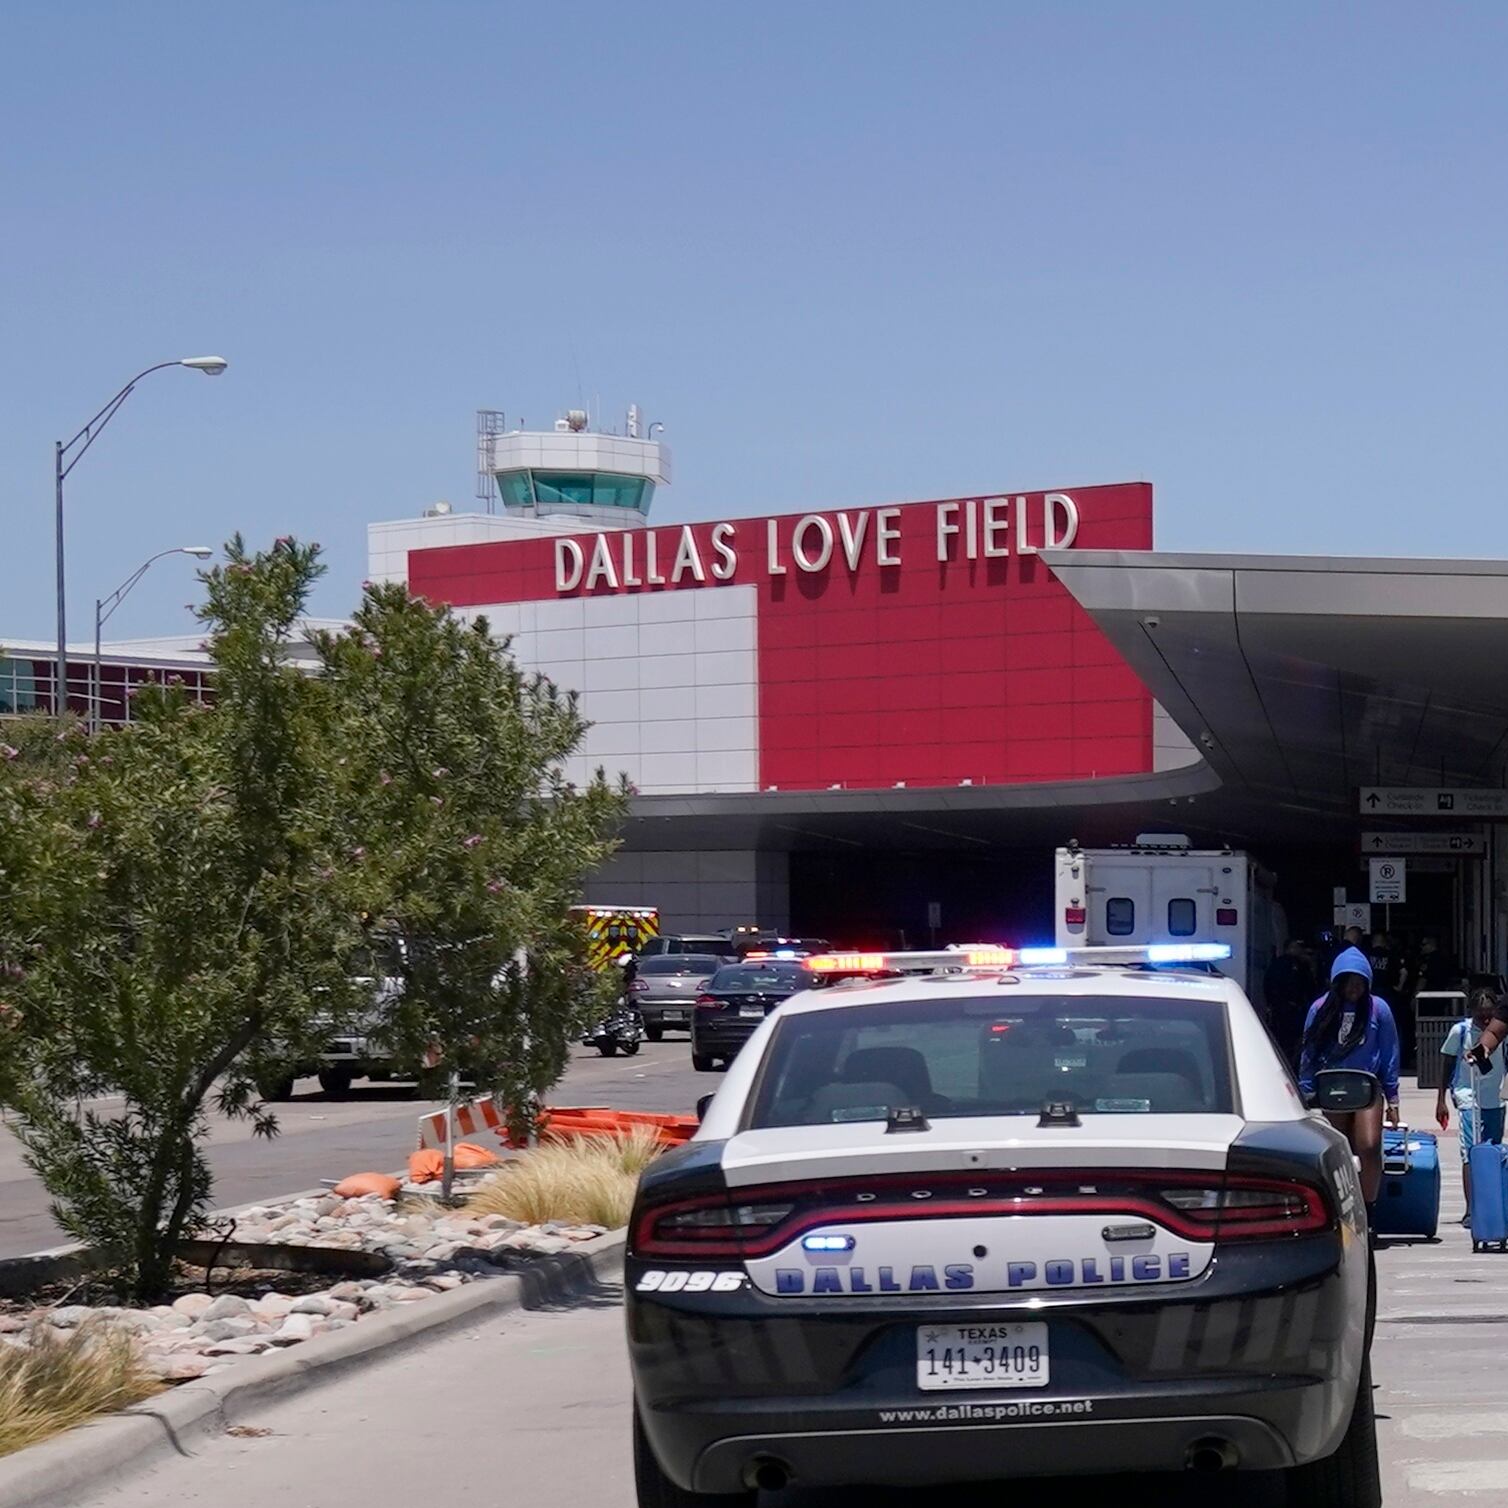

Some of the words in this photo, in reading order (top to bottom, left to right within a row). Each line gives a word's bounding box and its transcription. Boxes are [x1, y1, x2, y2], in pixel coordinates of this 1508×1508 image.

[555, 524, 736, 592] DALLAS
[767, 508, 903, 576] LOVE
[938, 494, 1078, 561] FIELD
[856, 1184, 1099, 1203] DODGE
[634, 1269, 747, 1294] 9096
[775, 1262, 975, 1297] DALLAS
[1007, 1254, 1190, 1287] POLICE
[957, 1327, 1009, 1340] TEXAS
[880, 1399, 1093, 1424] www.dallaspolice.net
